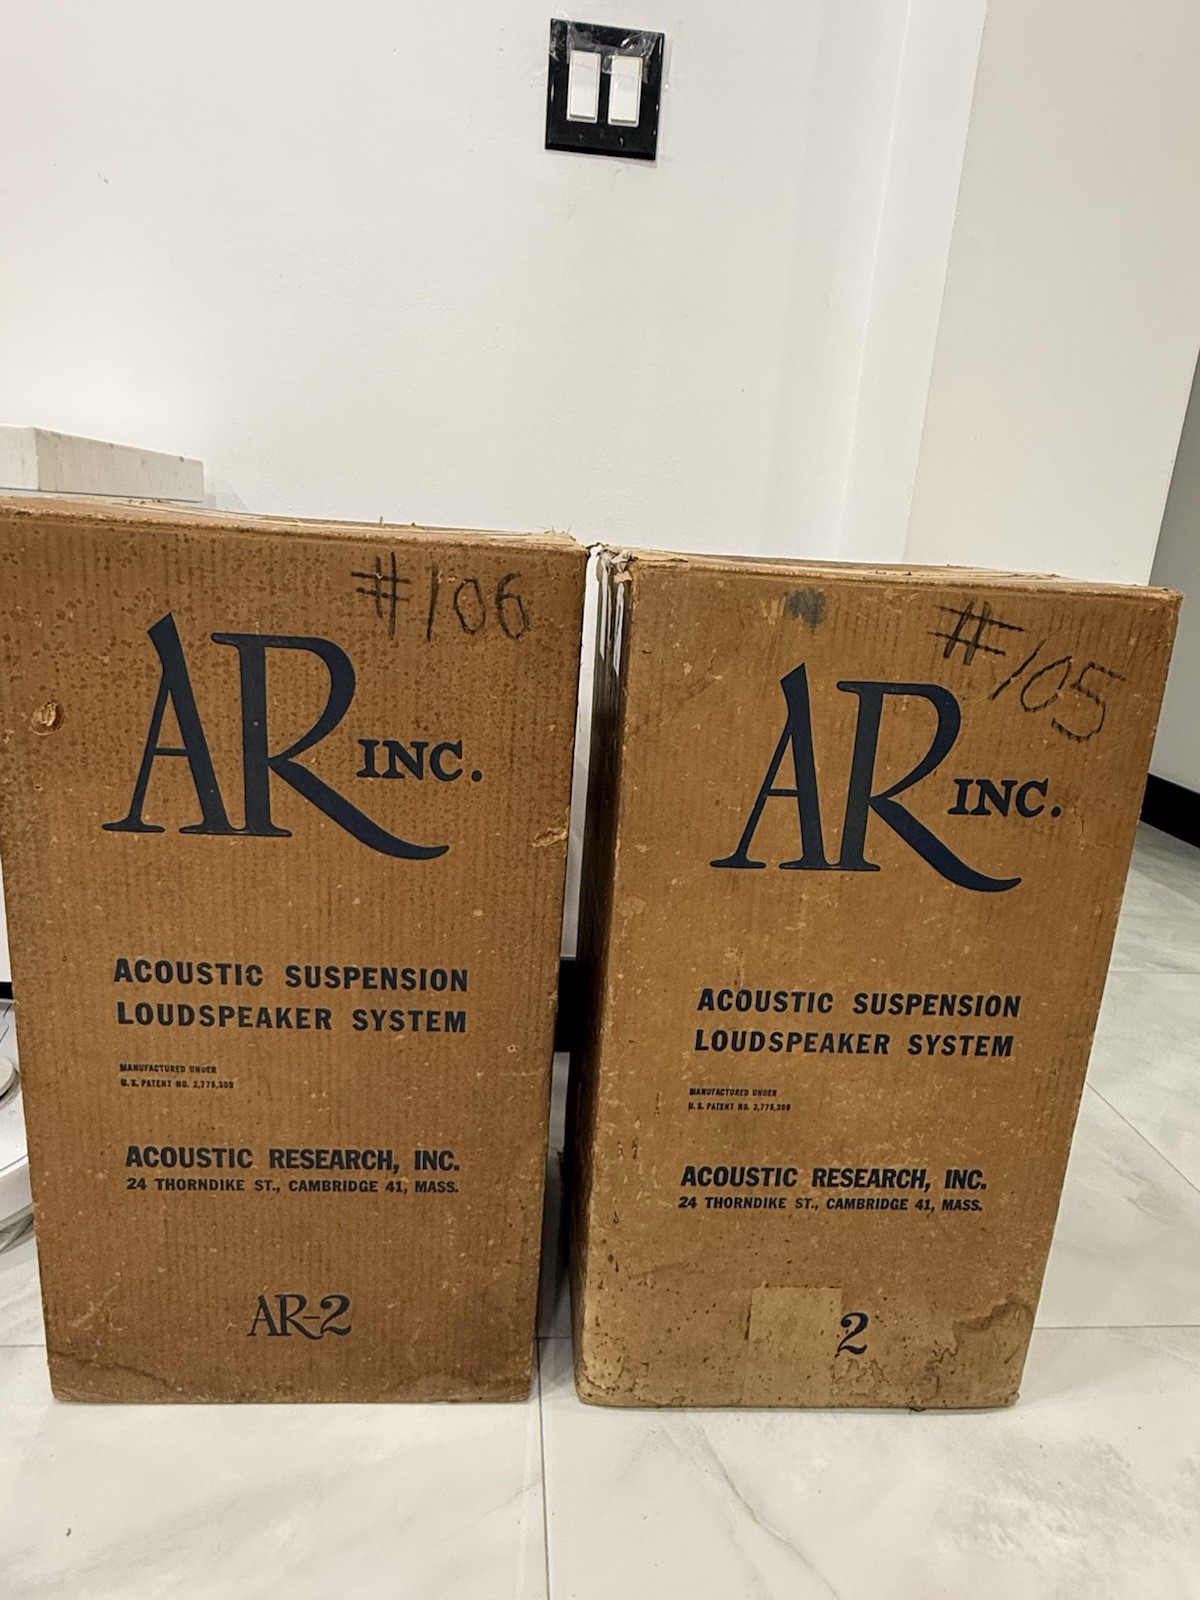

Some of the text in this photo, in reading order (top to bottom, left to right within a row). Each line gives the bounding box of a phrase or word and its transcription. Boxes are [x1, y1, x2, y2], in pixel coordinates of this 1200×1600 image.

[352, 552, 531, 642] #106
[927, 600, 1127, 743] #105
[102, 612, 483, 860] AR INC.
[709, 661, 1062, 892] AR INC.
[114, 958, 469, 992] ACOUSTIC SUSPENSION
[117, 1002, 467, 1033] LOUDSPEAKER SYSTEM
[697, 988, 1021, 1018] ACOUSTIC SUSPENSION
[694, 1029, 1014, 1057] LOUDSPEAKER SYSTEM
[119, 1063, 217, 1074] MANUFACTURED UNDER
[141, 1079, 172, 1088] PATENT
[689, 1087, 778, 1097] MANUFACTURED UNDER
[706, 1102, 735, 1111] PATENT
[737, 1103, 750, 1111] NO.
[125, 1145, 461, 1173] ACOUSTIC RESEARCH, INC.
[126, 1177, 459, 1194] 24 THORNDIKE ST., CAMBRIDGE 41, MASS.
[680, 1166, 987, 1191] ACOUSTIC RESEARCH, INC.
[678, 1196, 983, 1213] 24 THORNDIKE ST., CAMBRIDGE 41, MASS.
[247, 1293, 352, 1340] AR-2
[835, 1311, 869, 1356] 2
